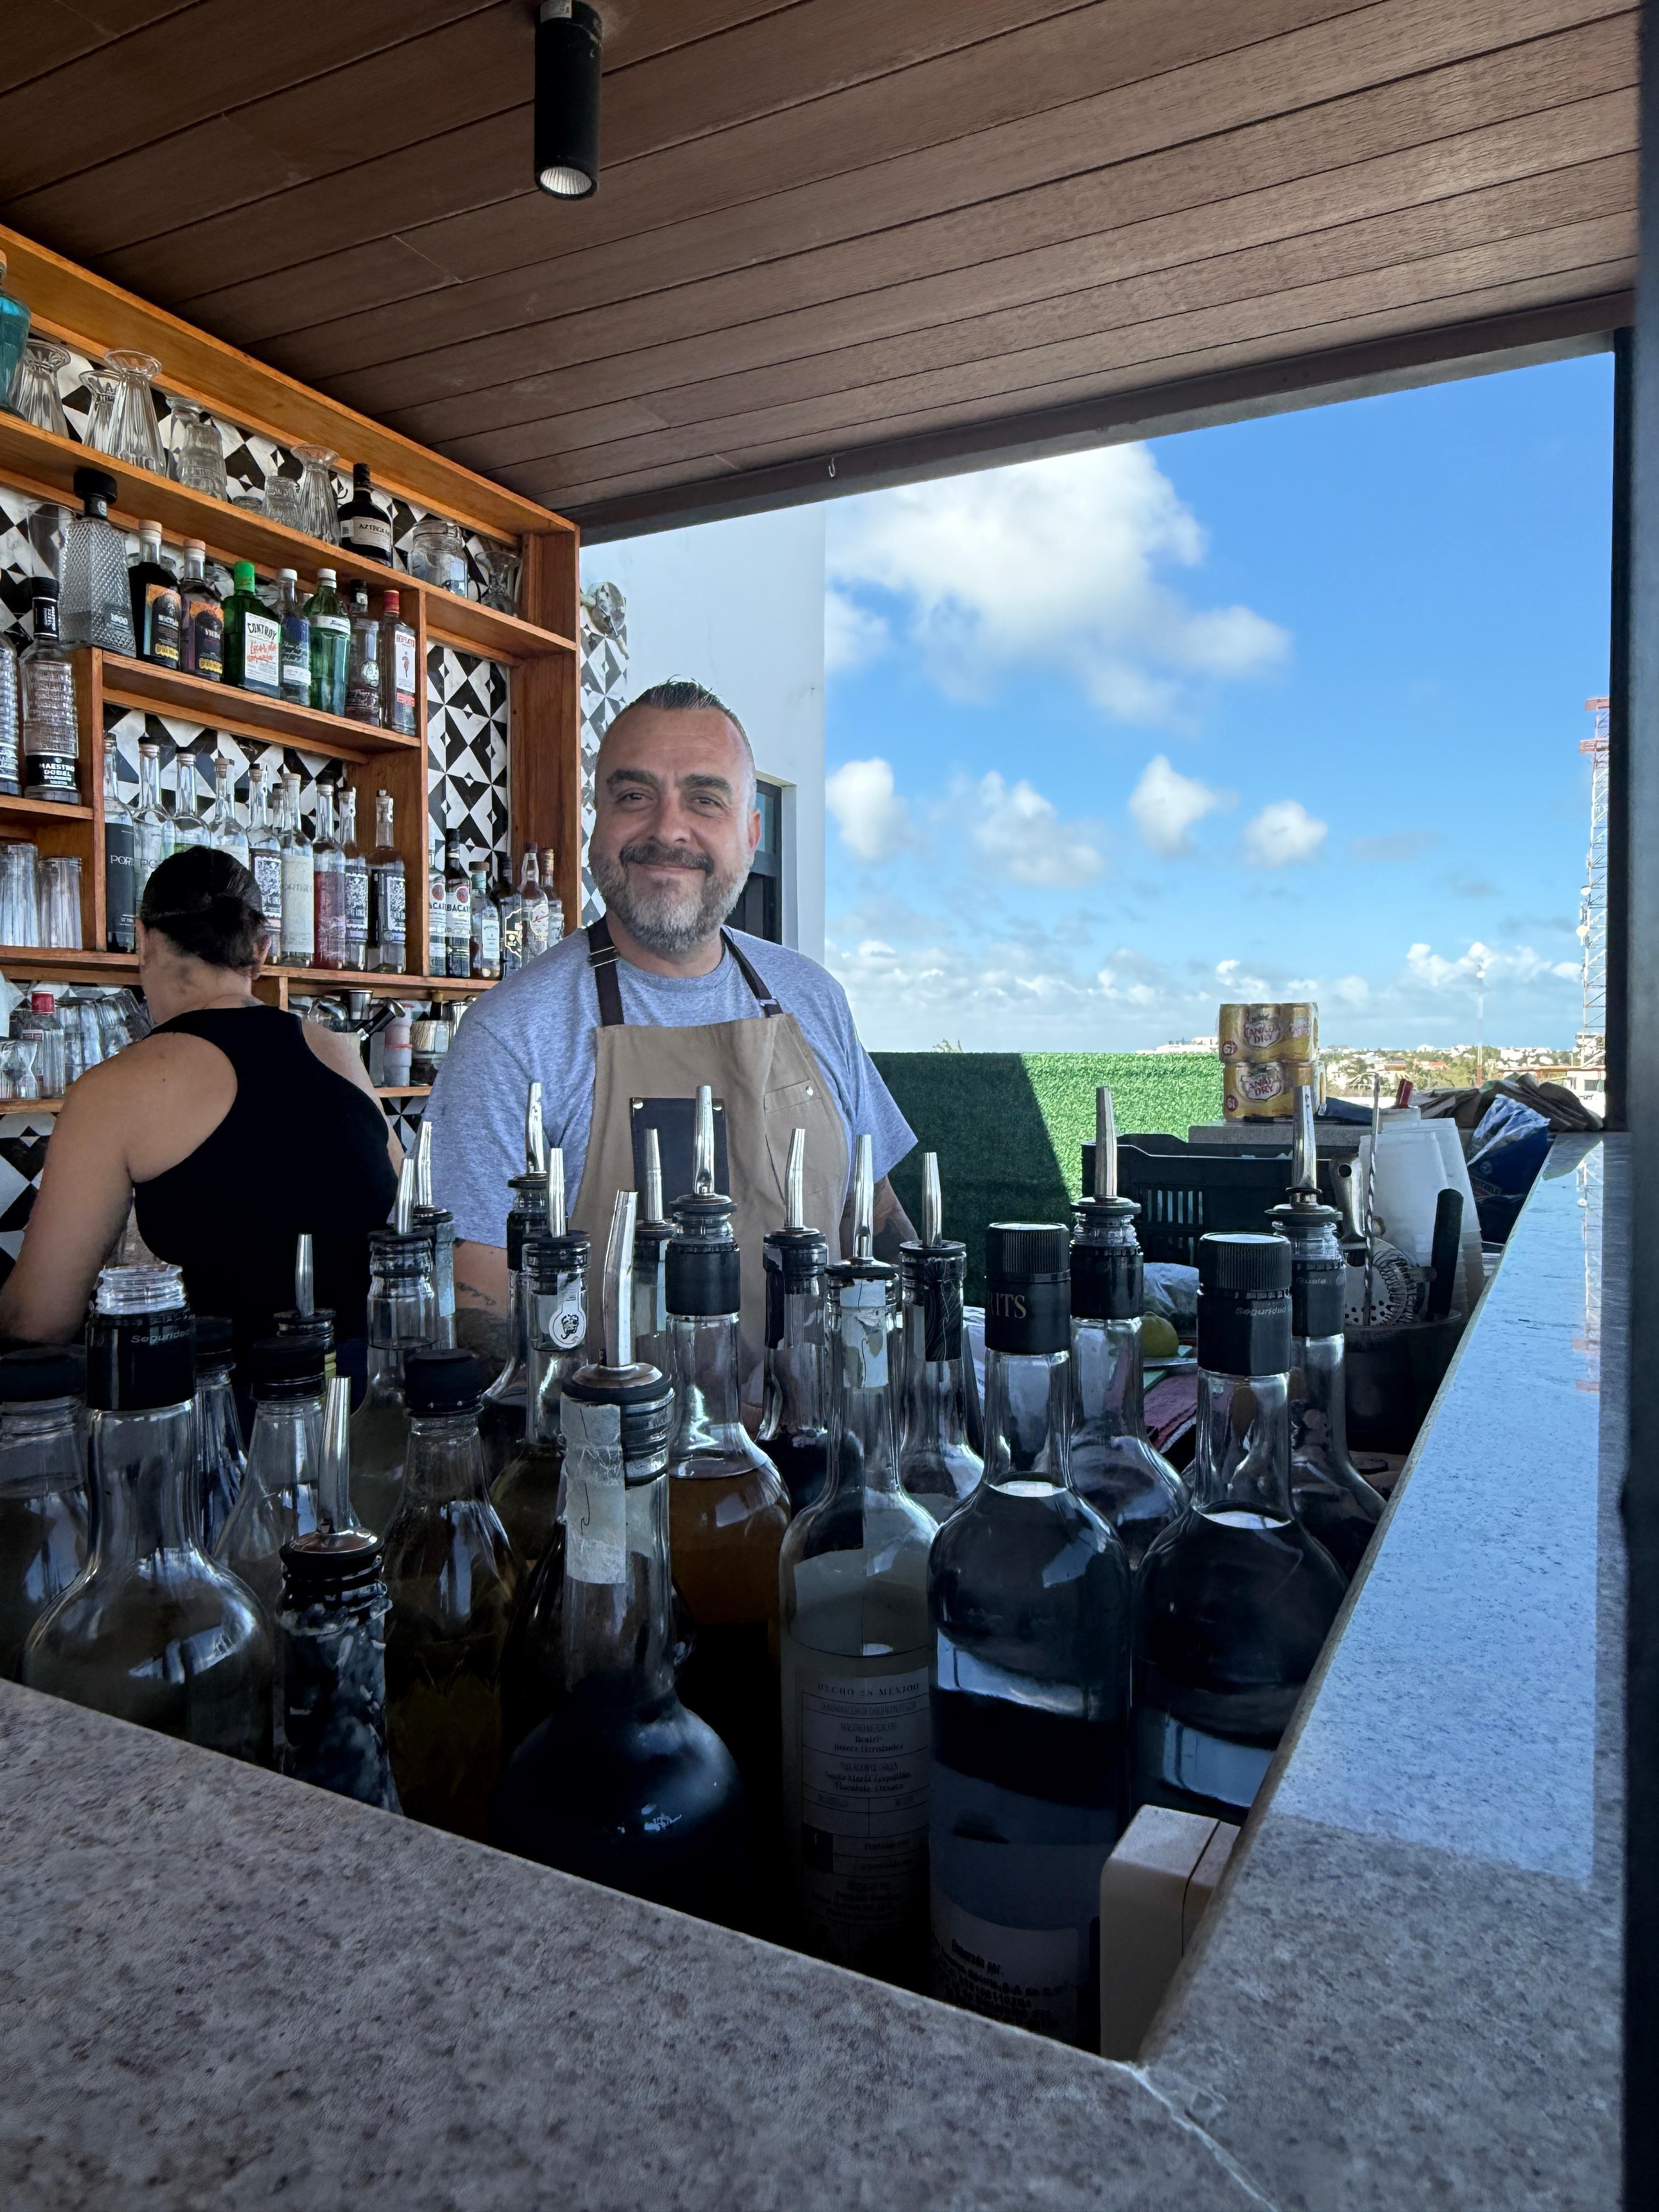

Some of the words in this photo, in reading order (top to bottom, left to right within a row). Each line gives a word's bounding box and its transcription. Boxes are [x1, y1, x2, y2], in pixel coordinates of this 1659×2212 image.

[247, 623, 277, 641] CONTROY
[39, 763, 75, 772] MAESTRO
[1255, 1085, 1273, 1096] DRY
[131, 1329, 190, 1345] Seguridad
[817, 1681, 855, 1696] HECHO
